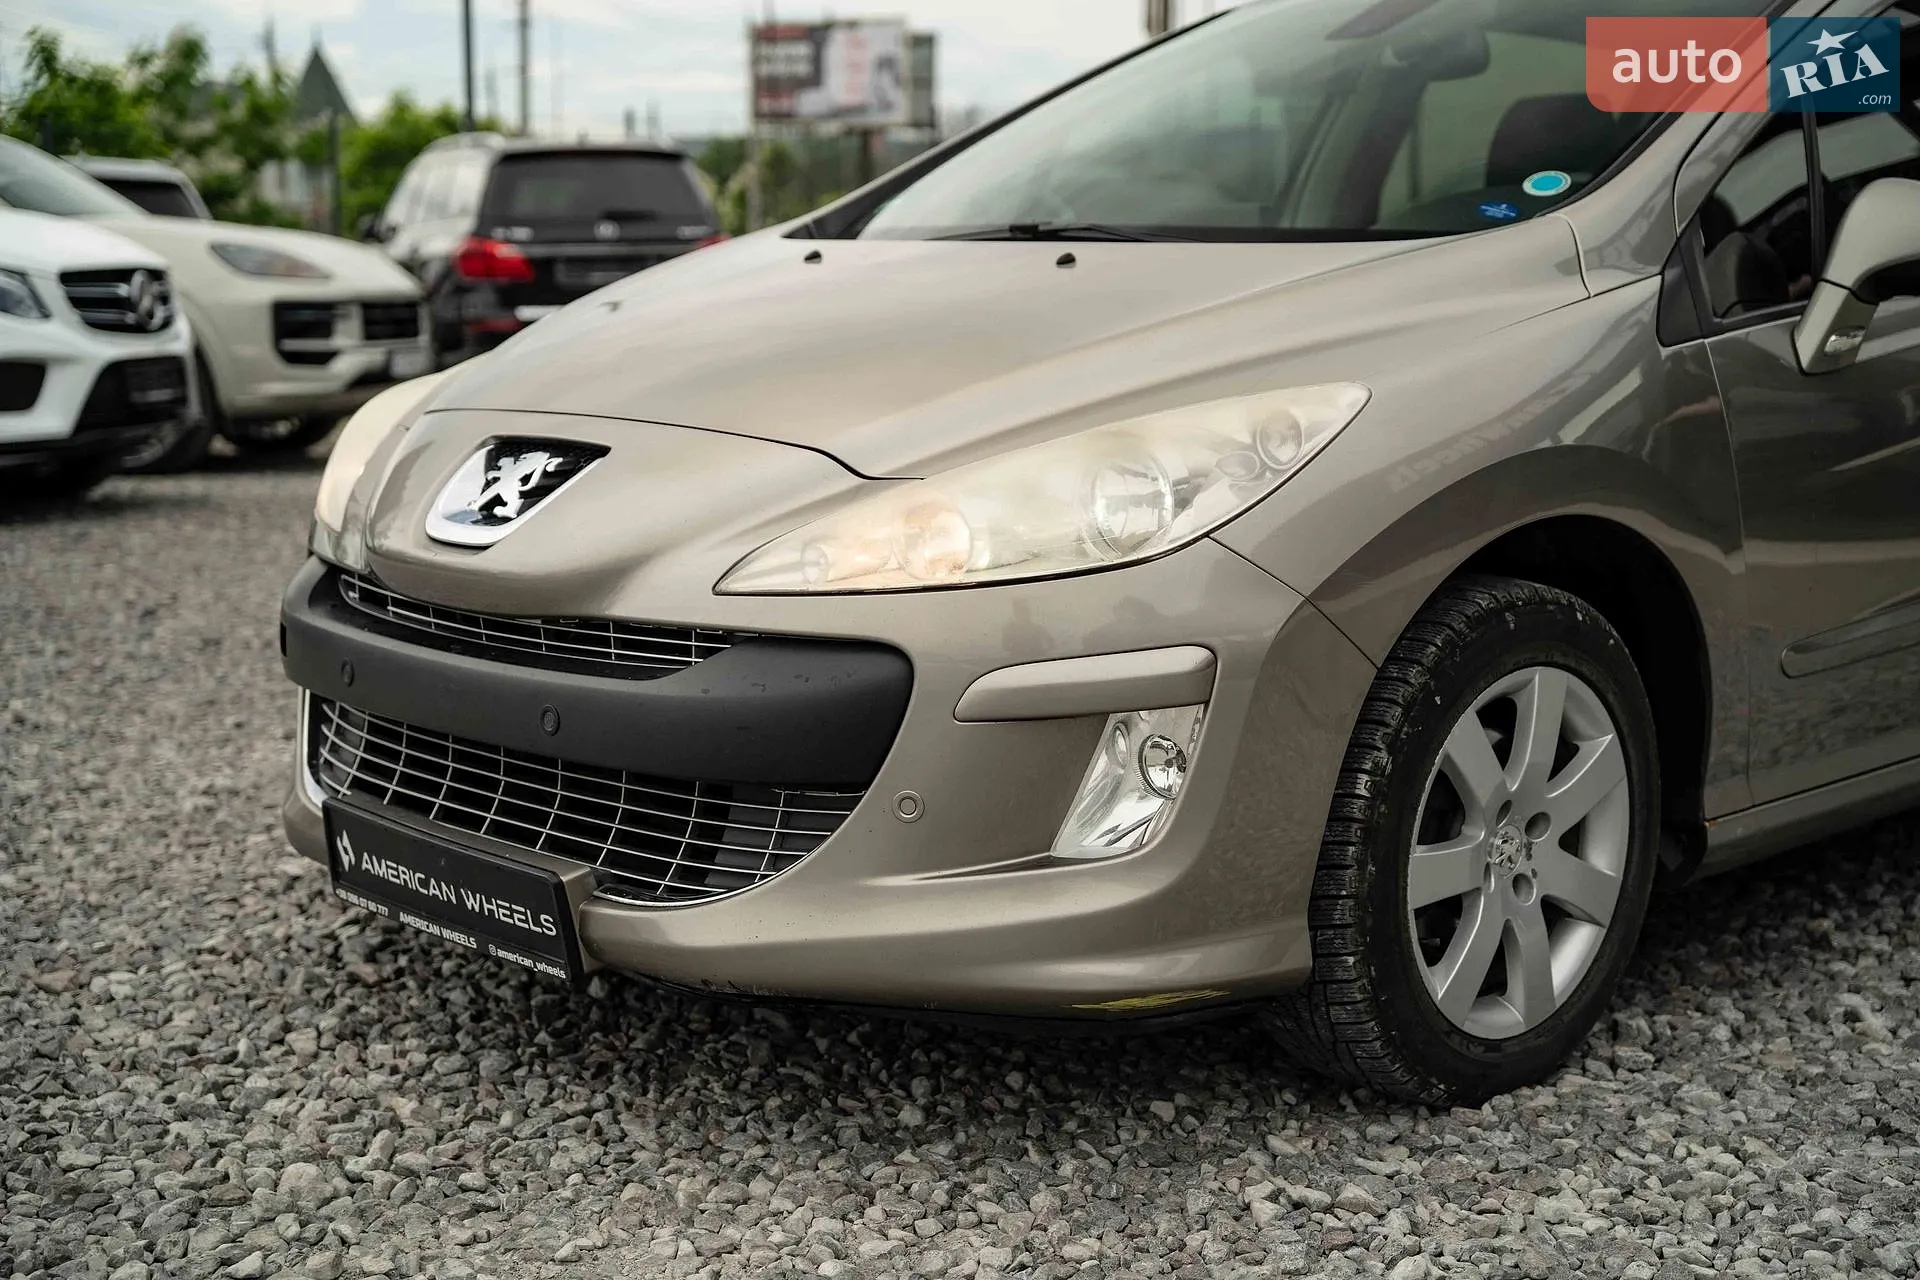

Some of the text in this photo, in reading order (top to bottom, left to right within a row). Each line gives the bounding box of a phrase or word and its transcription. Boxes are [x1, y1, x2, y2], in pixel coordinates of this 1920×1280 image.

[361, 852, 557, 936] AMERICAN WHEELS
[399, 911, 477, 949] AMERICAN WHEELS
